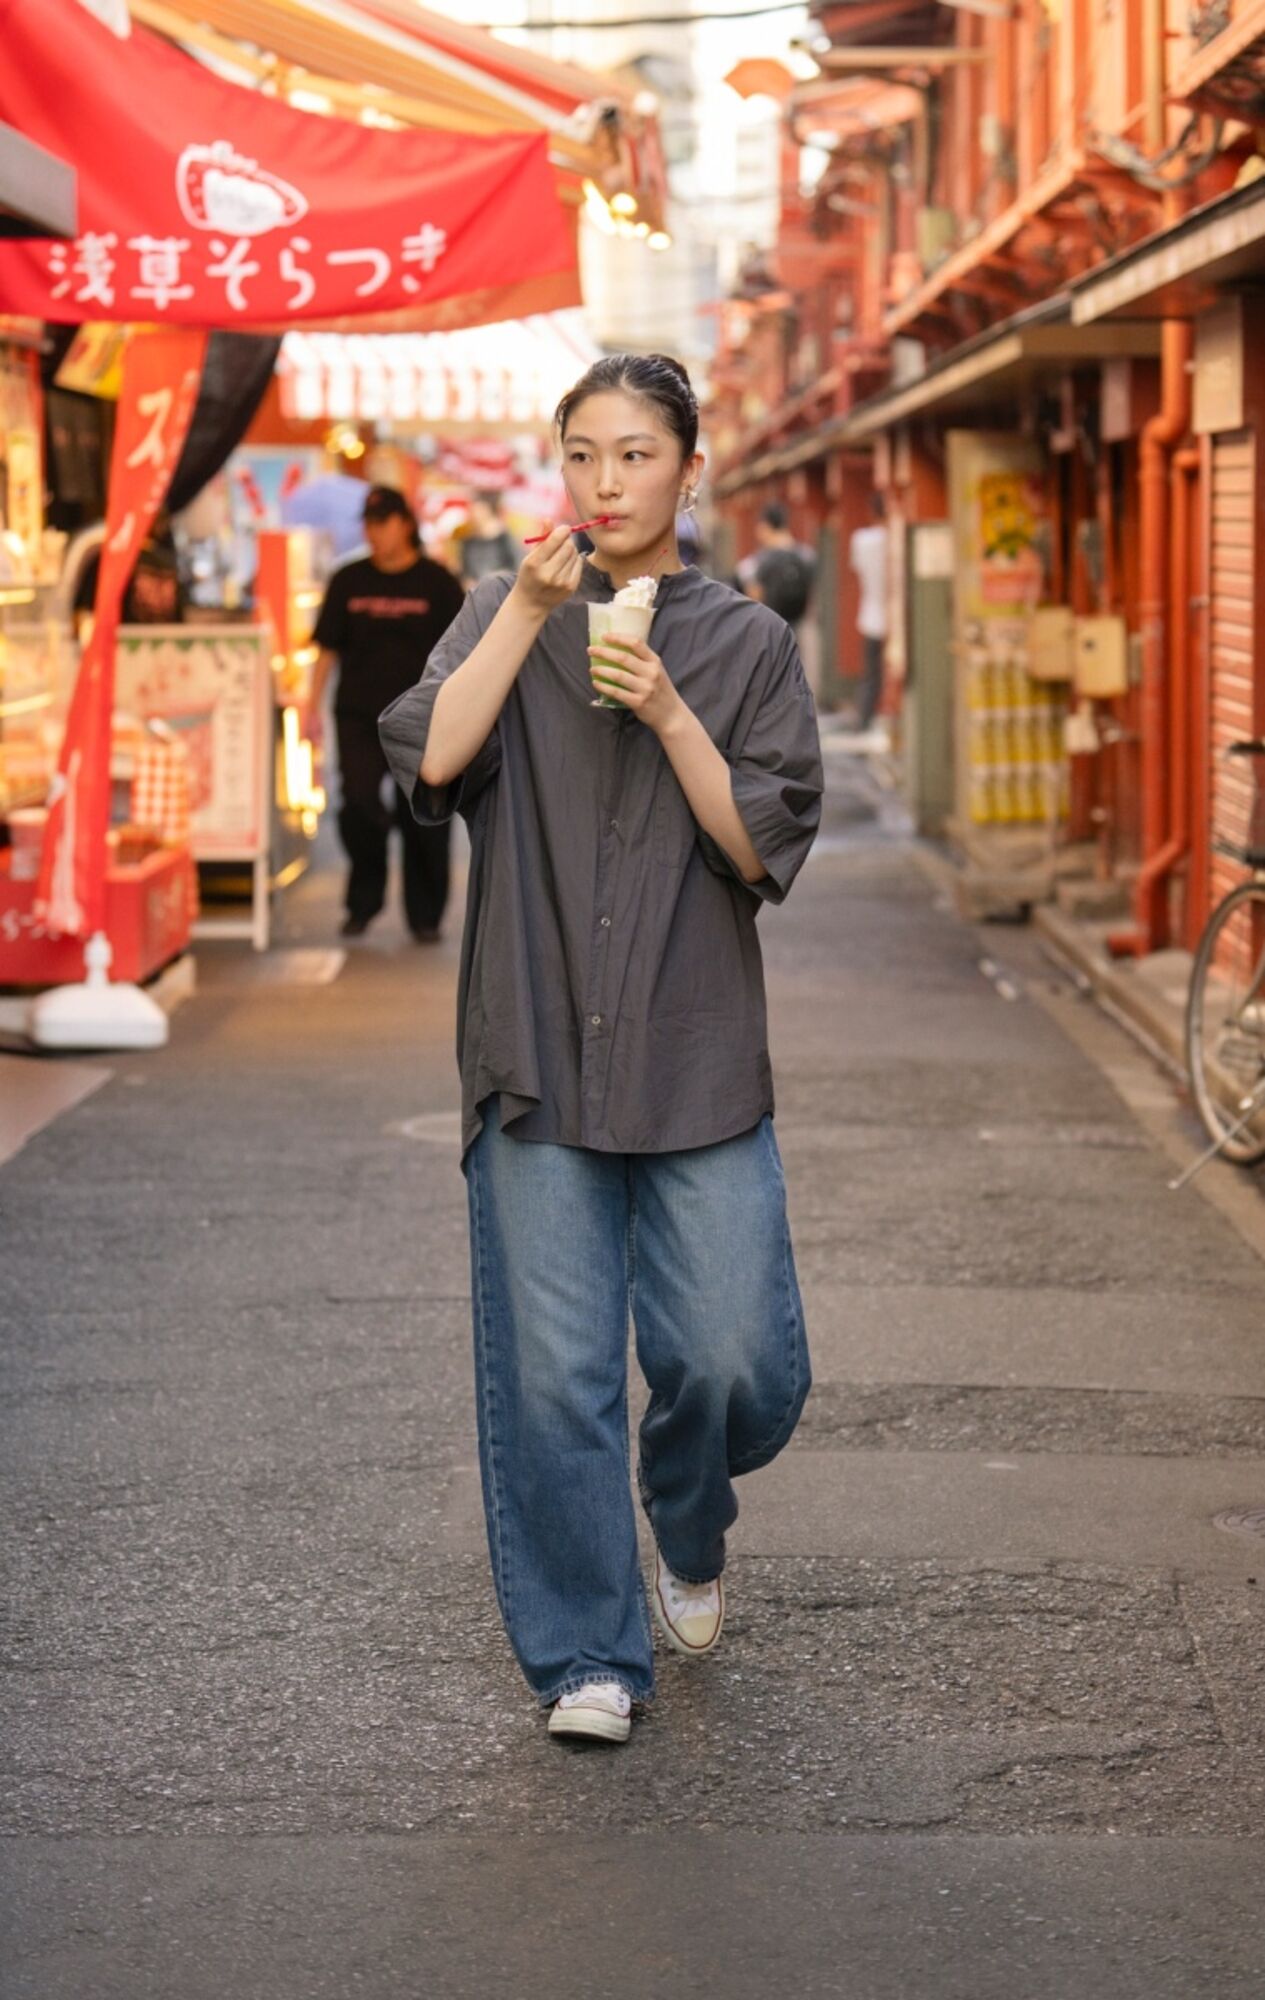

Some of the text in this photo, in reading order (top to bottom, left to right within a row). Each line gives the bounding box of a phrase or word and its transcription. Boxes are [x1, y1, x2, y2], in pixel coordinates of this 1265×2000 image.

[48, 223, 447, 311] 浅草そらつき
